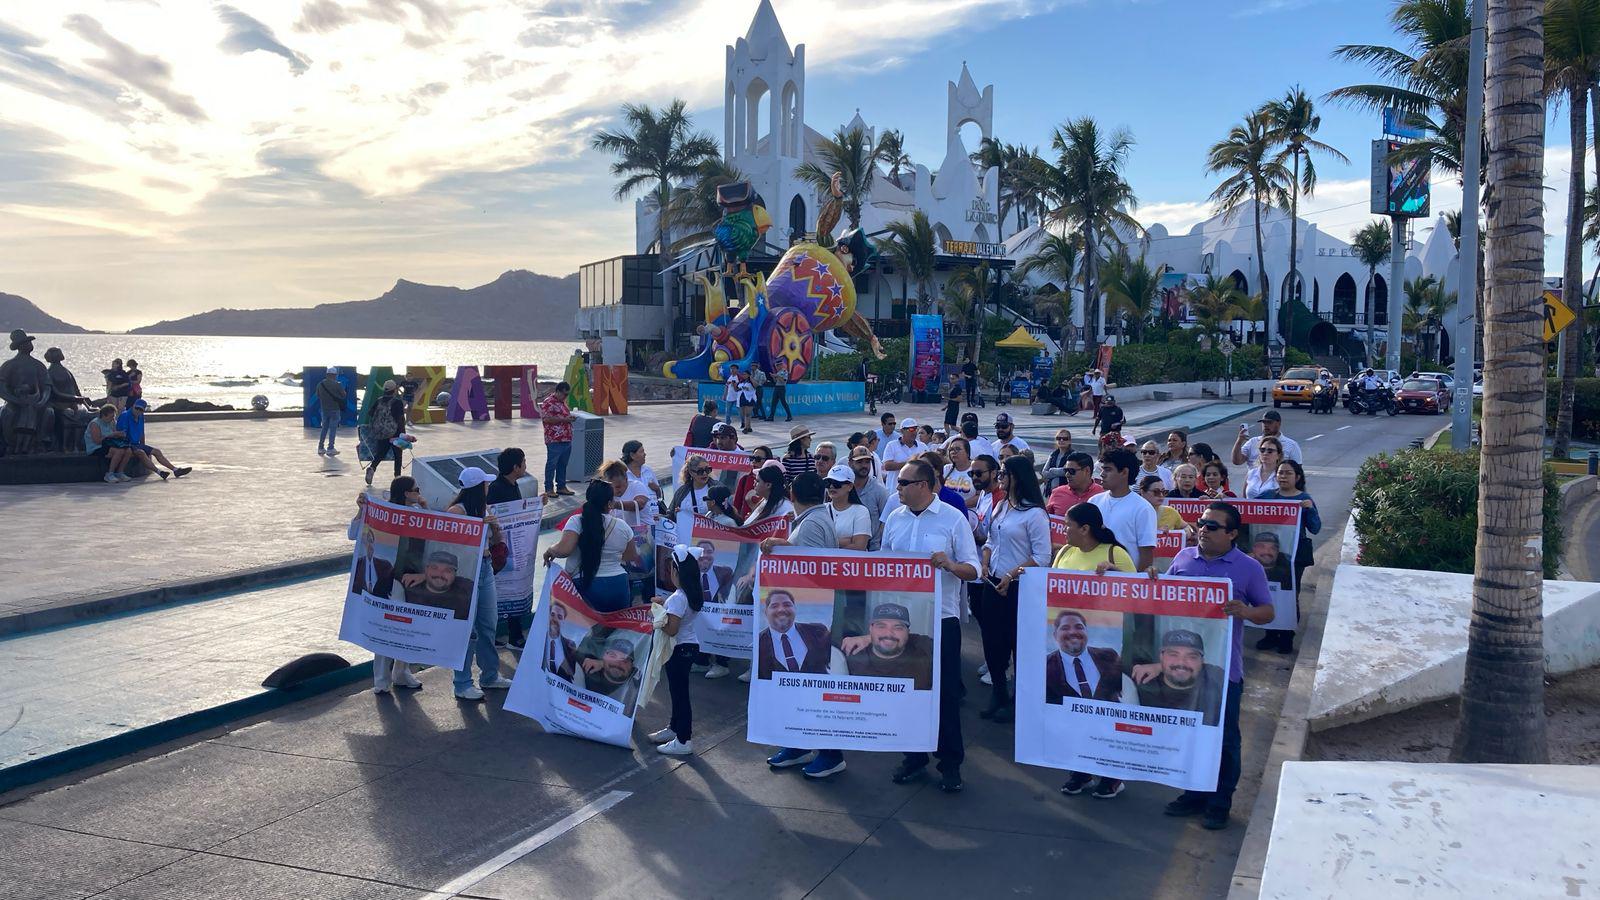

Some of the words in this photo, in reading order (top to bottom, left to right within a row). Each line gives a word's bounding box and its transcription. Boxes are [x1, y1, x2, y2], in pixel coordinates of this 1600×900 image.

[717, 455, 727, 464] DE
[728, 456, 739, 465] SU
[1247, 505, 1298, 517] LIBERTAD
[392, 512, 406, 526] DE
[408, 515, 423, 528] SU
[426, 519, 481, 536] LIBERTAD
[760, 559, 817, 575] PRIVADO
[821, 562, 838, 576] DE
[842, 562, 859, 577] SU
[864, 563, 932, 579] LIBERTAD
[1049, 578, 1108, 597] PRIVADO
[1112, 582, 1127, 598] DE
[1131, 583, 1149, 600] SU
[1152, 585, 1225, 604] LIBERTAD
[372, 601, 395, 612] ANTONIO
[395, 604, 433, 618] HERNANDEZ
[433, 611, 448, 620] RUIZ
[779, 677, 801, 688] JESUS
[802, 679, 836, 690] ANTONIO
[838, 681, 885, 693] HERNANDEZ
[887, 683, 906, 693] RUIZ
[577, 691, 609, 709] HERNANDEZ
[1071, 703, 1093, 714] JESUS
[1095, 706, 1128, 719] ANTONIO
[1129, 710, 1178, 725] HERNANDEZ
[1180, 716, 1197, 727] RUIZ
